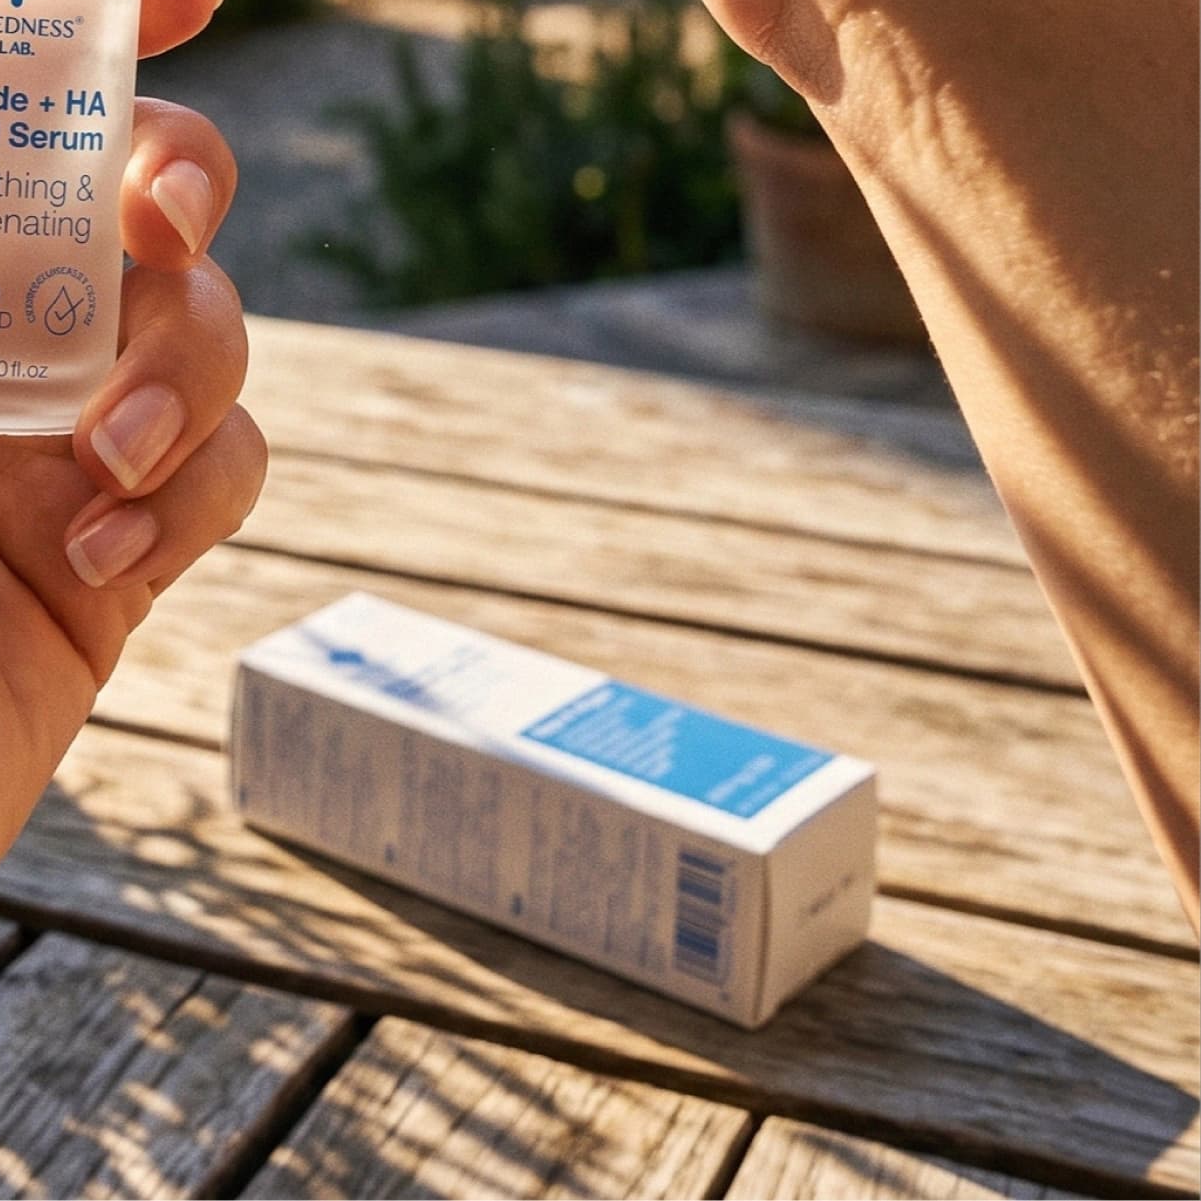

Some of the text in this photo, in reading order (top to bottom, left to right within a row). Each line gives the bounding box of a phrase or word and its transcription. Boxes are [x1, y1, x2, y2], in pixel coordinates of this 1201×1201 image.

[39, 97, 55, 112] +
[66, 89, 106, 117] HA
[8, 122, 104, 151] Serum
[76, 174, 94, 202] &
